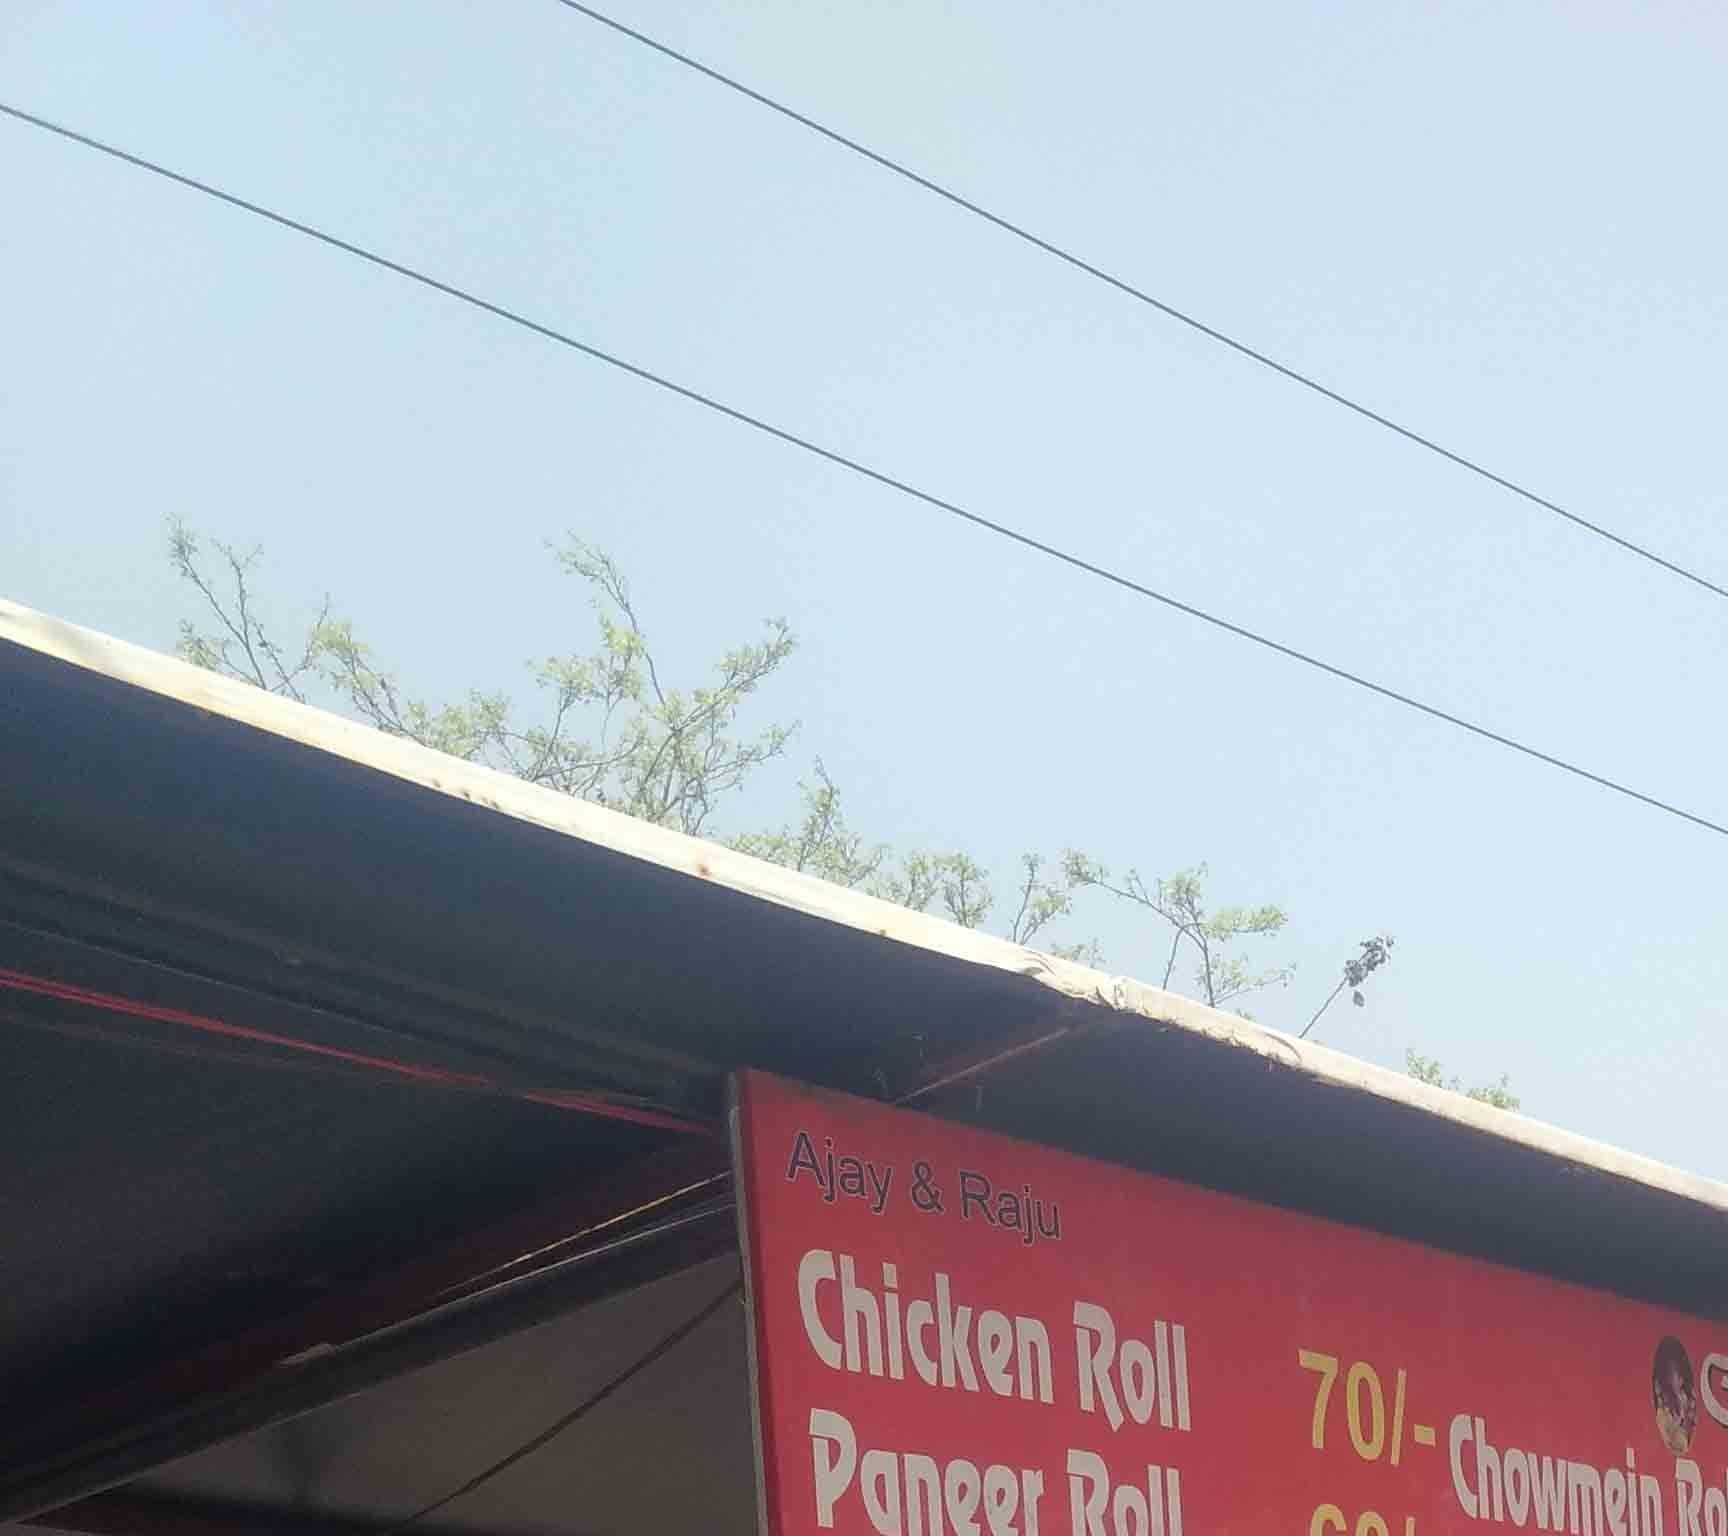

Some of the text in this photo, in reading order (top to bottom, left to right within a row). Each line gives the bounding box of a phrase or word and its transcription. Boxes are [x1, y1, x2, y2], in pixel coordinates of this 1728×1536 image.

[785, 1128, 1062, 1247] Ajay & Raju
[797, 1248, 1436, 1467] Chicken Roll 70/-
